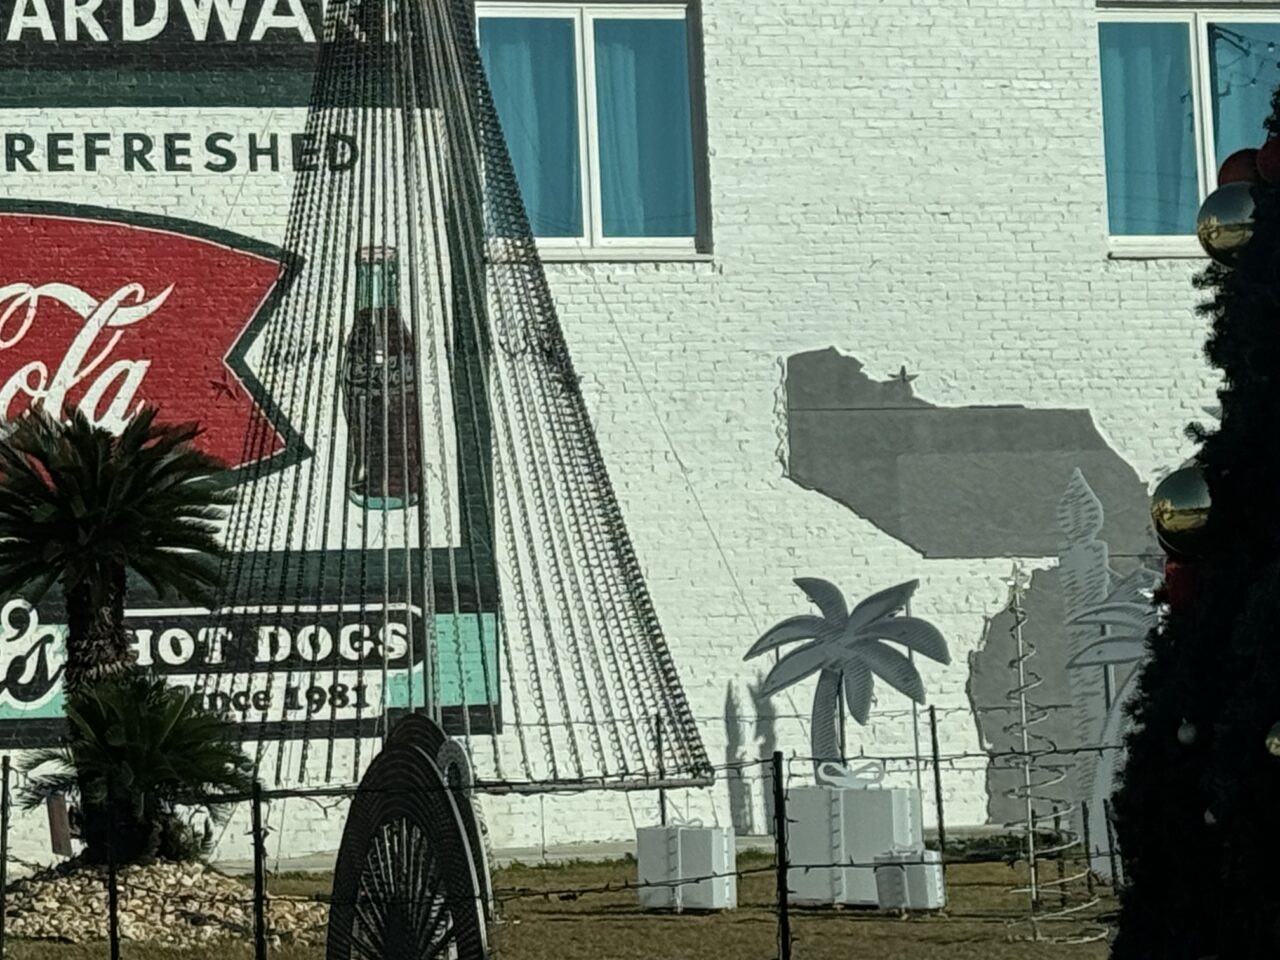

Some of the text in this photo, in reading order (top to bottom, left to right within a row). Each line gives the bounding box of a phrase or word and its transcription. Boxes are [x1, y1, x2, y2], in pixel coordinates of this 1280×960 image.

[5, 132, 359, 172] REFRESHED
[254, 622, 408, 663] DOGS
[285, 682, 371, 714] 1981
